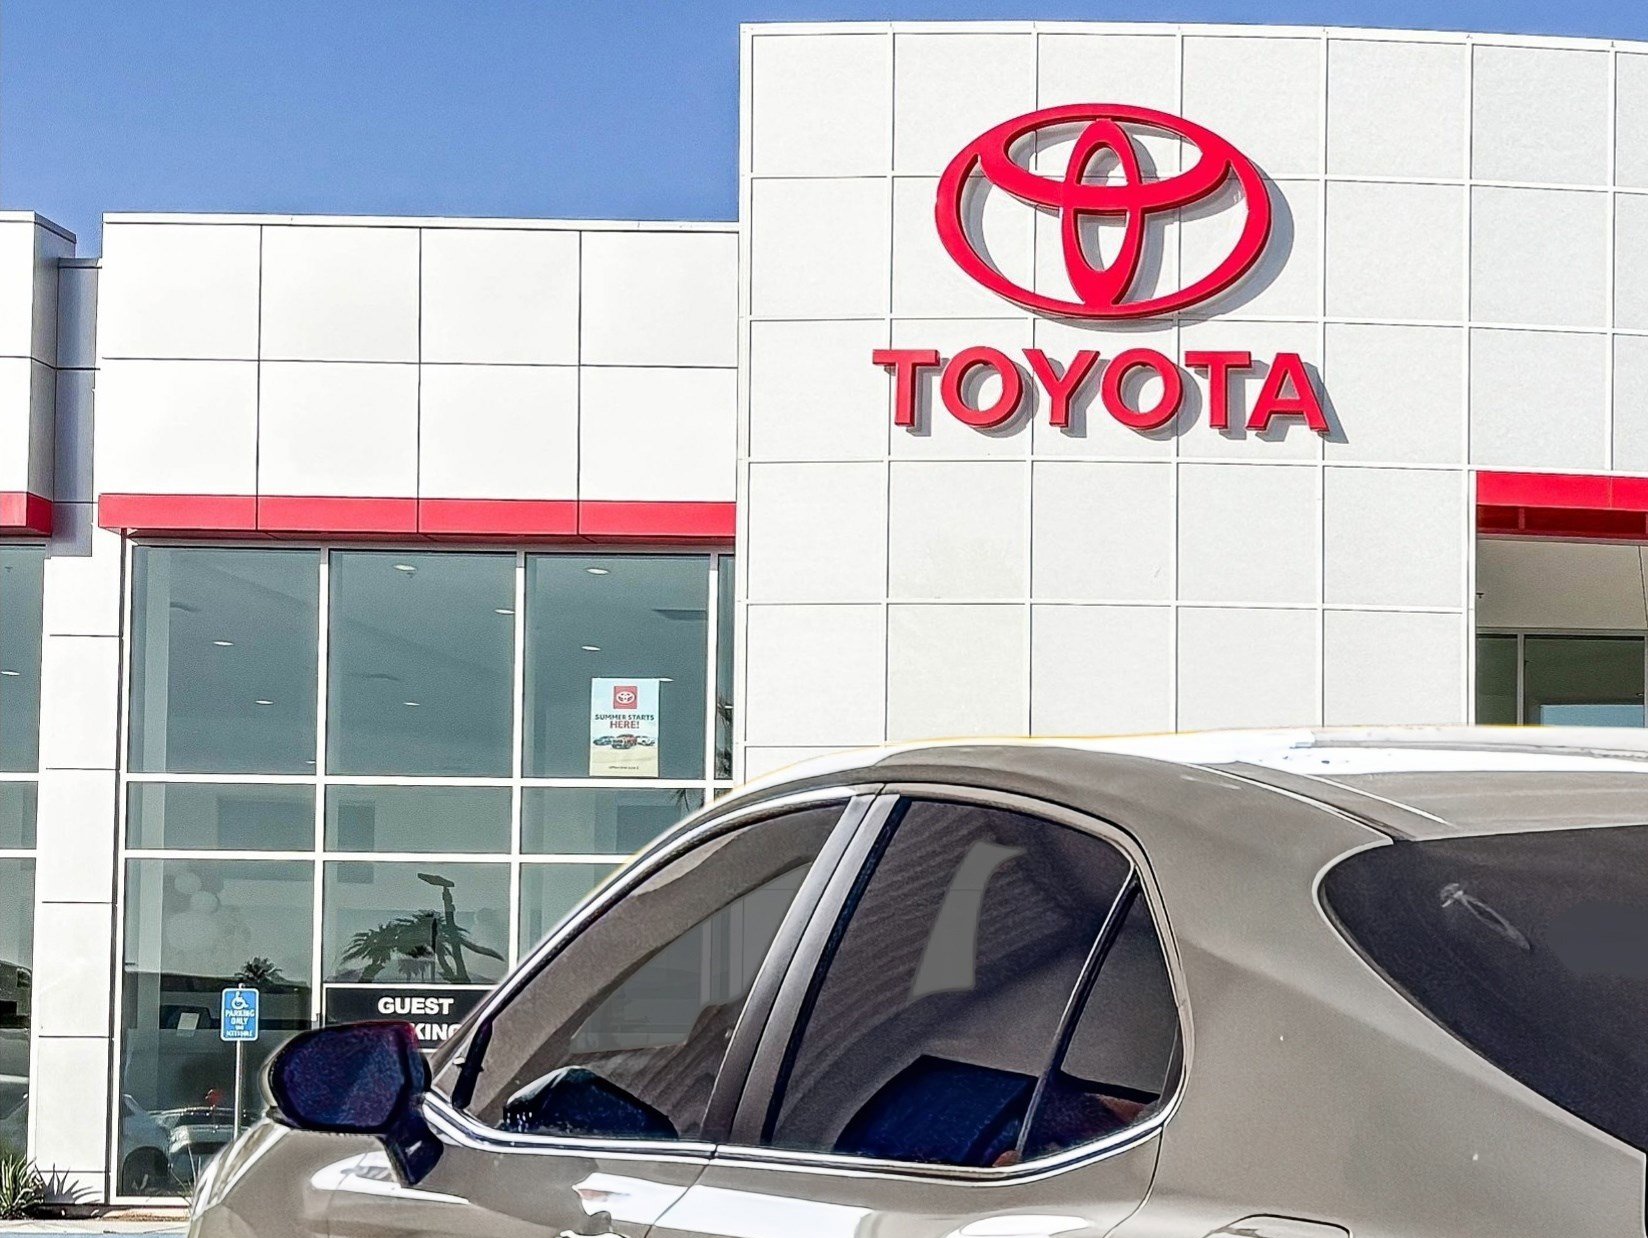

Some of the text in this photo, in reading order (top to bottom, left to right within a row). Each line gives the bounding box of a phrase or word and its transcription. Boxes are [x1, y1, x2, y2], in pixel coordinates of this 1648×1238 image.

[872, 346, 1330, 433] TOYOTA
[609, 720, 640, 729] HERE!
[377, 997, 454, 1015] GUEST
